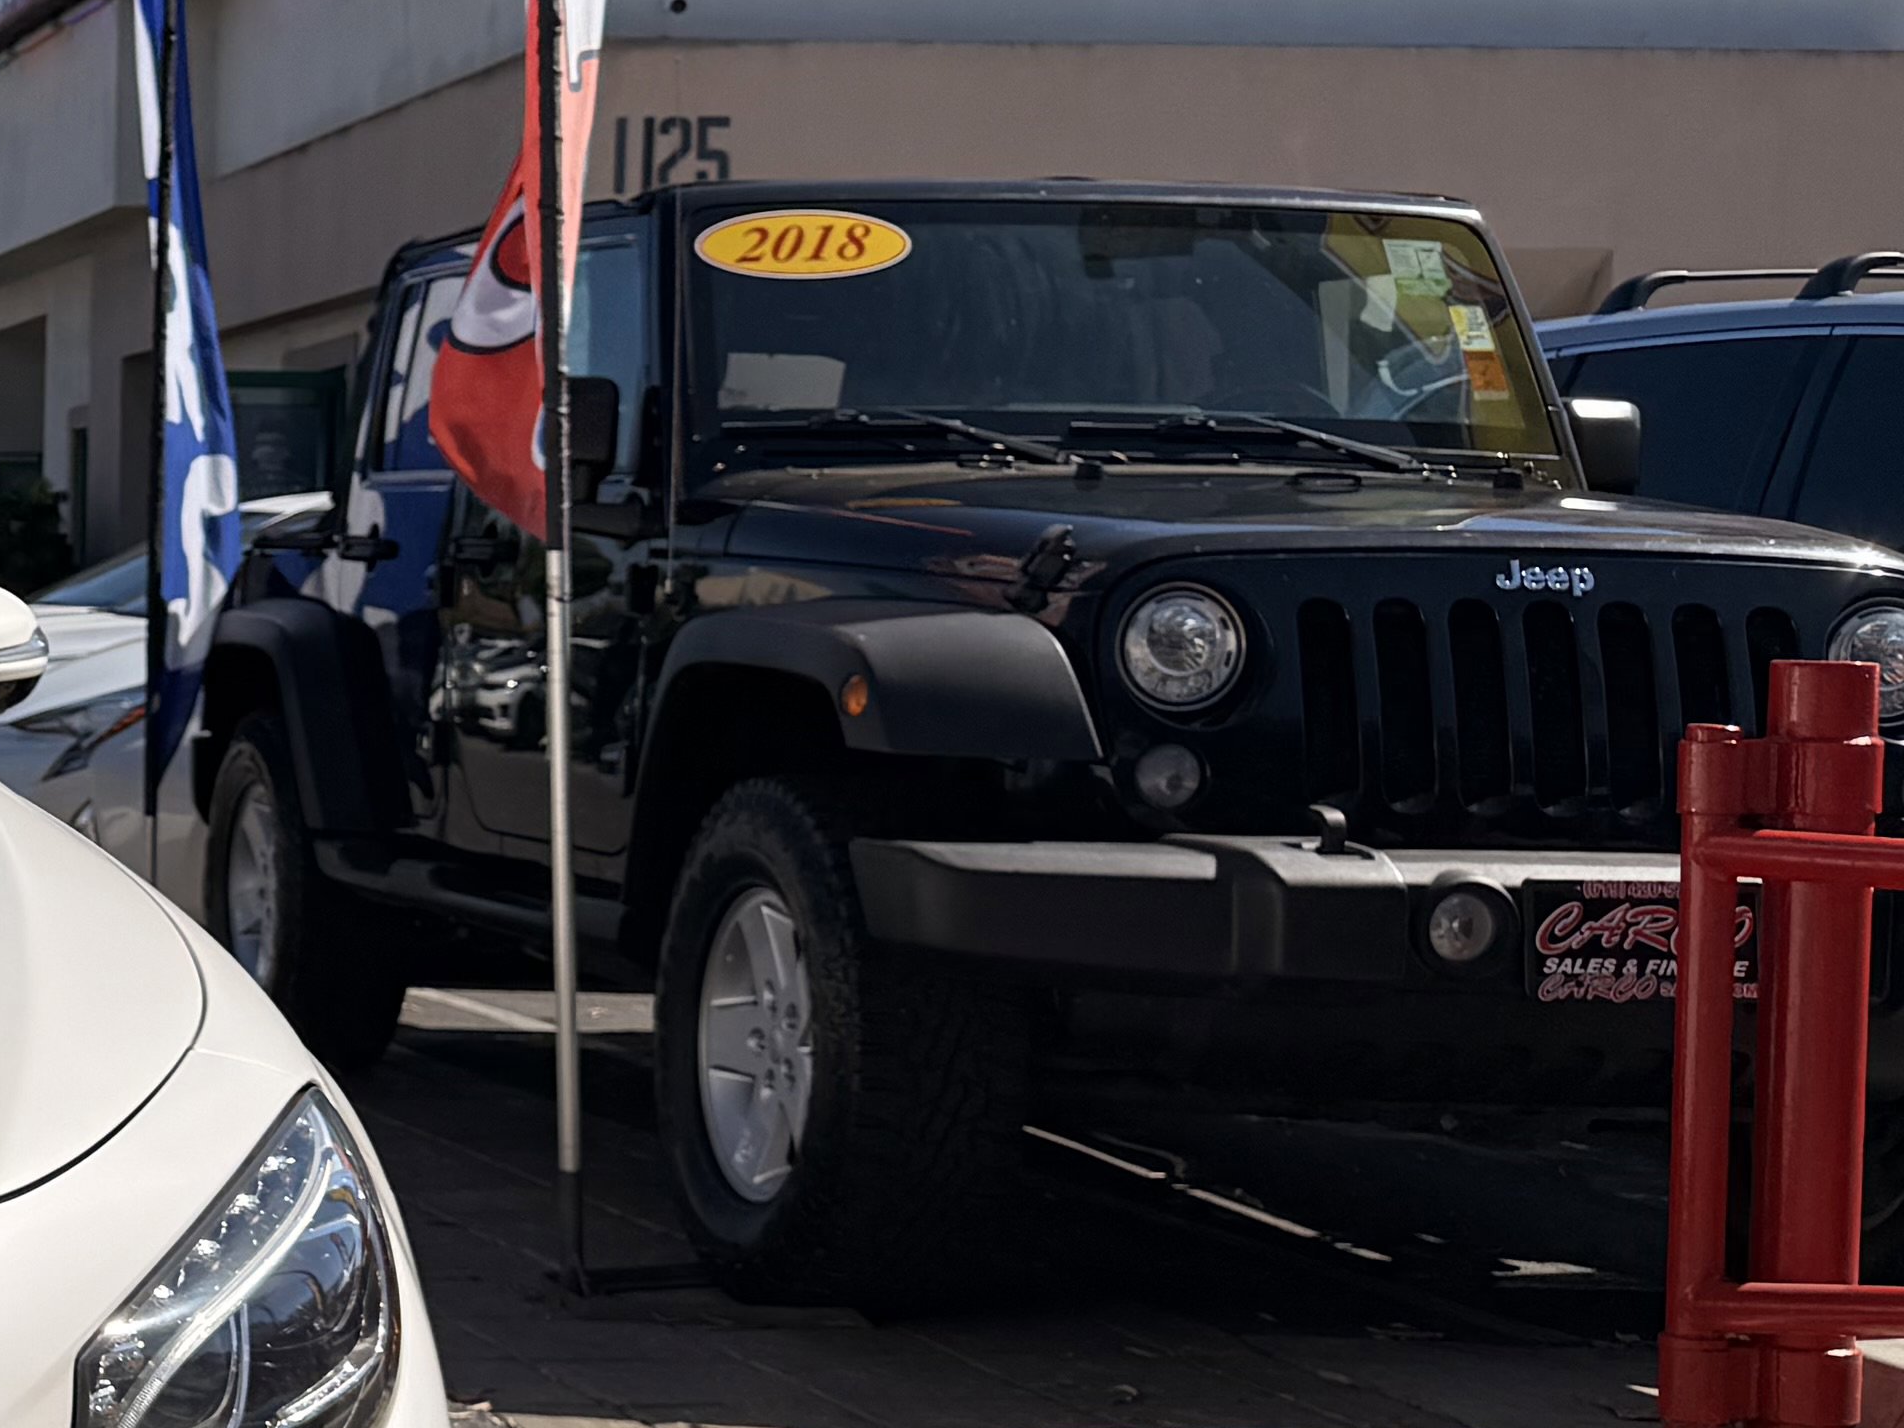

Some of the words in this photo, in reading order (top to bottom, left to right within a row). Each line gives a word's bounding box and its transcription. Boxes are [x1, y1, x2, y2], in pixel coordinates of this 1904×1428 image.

[613, 115, 732, 194] 1125
[735, 223, 872, 264] 2018
[1495, 559, 1595, 597] Jeep
[1536, 901, 1754, 956] CAR
[1543, 957, 1617, 975] SALES
[1622, 959, 1638, 976] &
[1646, 958, 1749, 978] FINE
[1538, 974, 1658, 1003] CARCO
